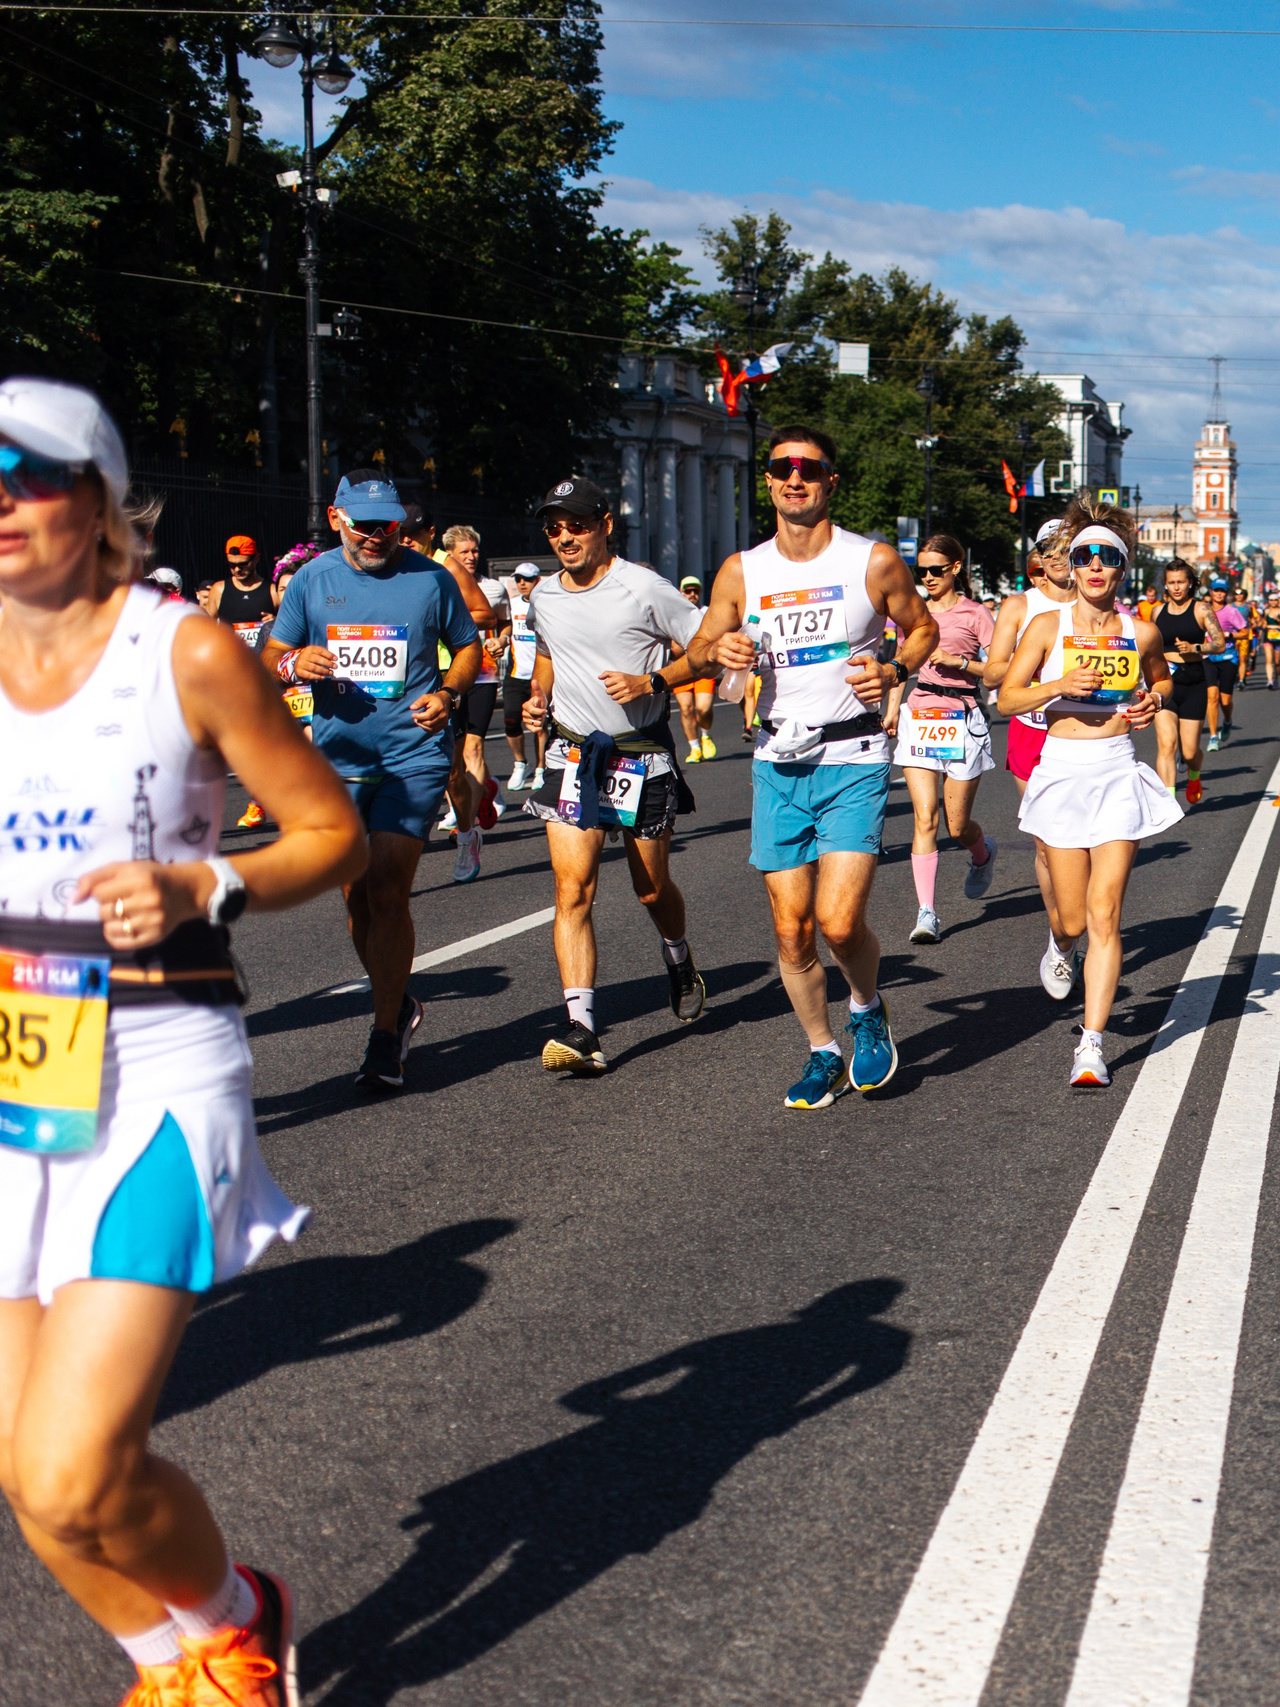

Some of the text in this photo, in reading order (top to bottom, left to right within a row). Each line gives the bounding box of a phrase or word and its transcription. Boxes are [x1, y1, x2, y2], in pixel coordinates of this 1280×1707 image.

[774, 608, 833, 636] 1737
[786, 632, 826, 645] ГРИГОРИЙ
[338, 646, 397, 668] 5408
[918, 726, 957, 741] 7499
